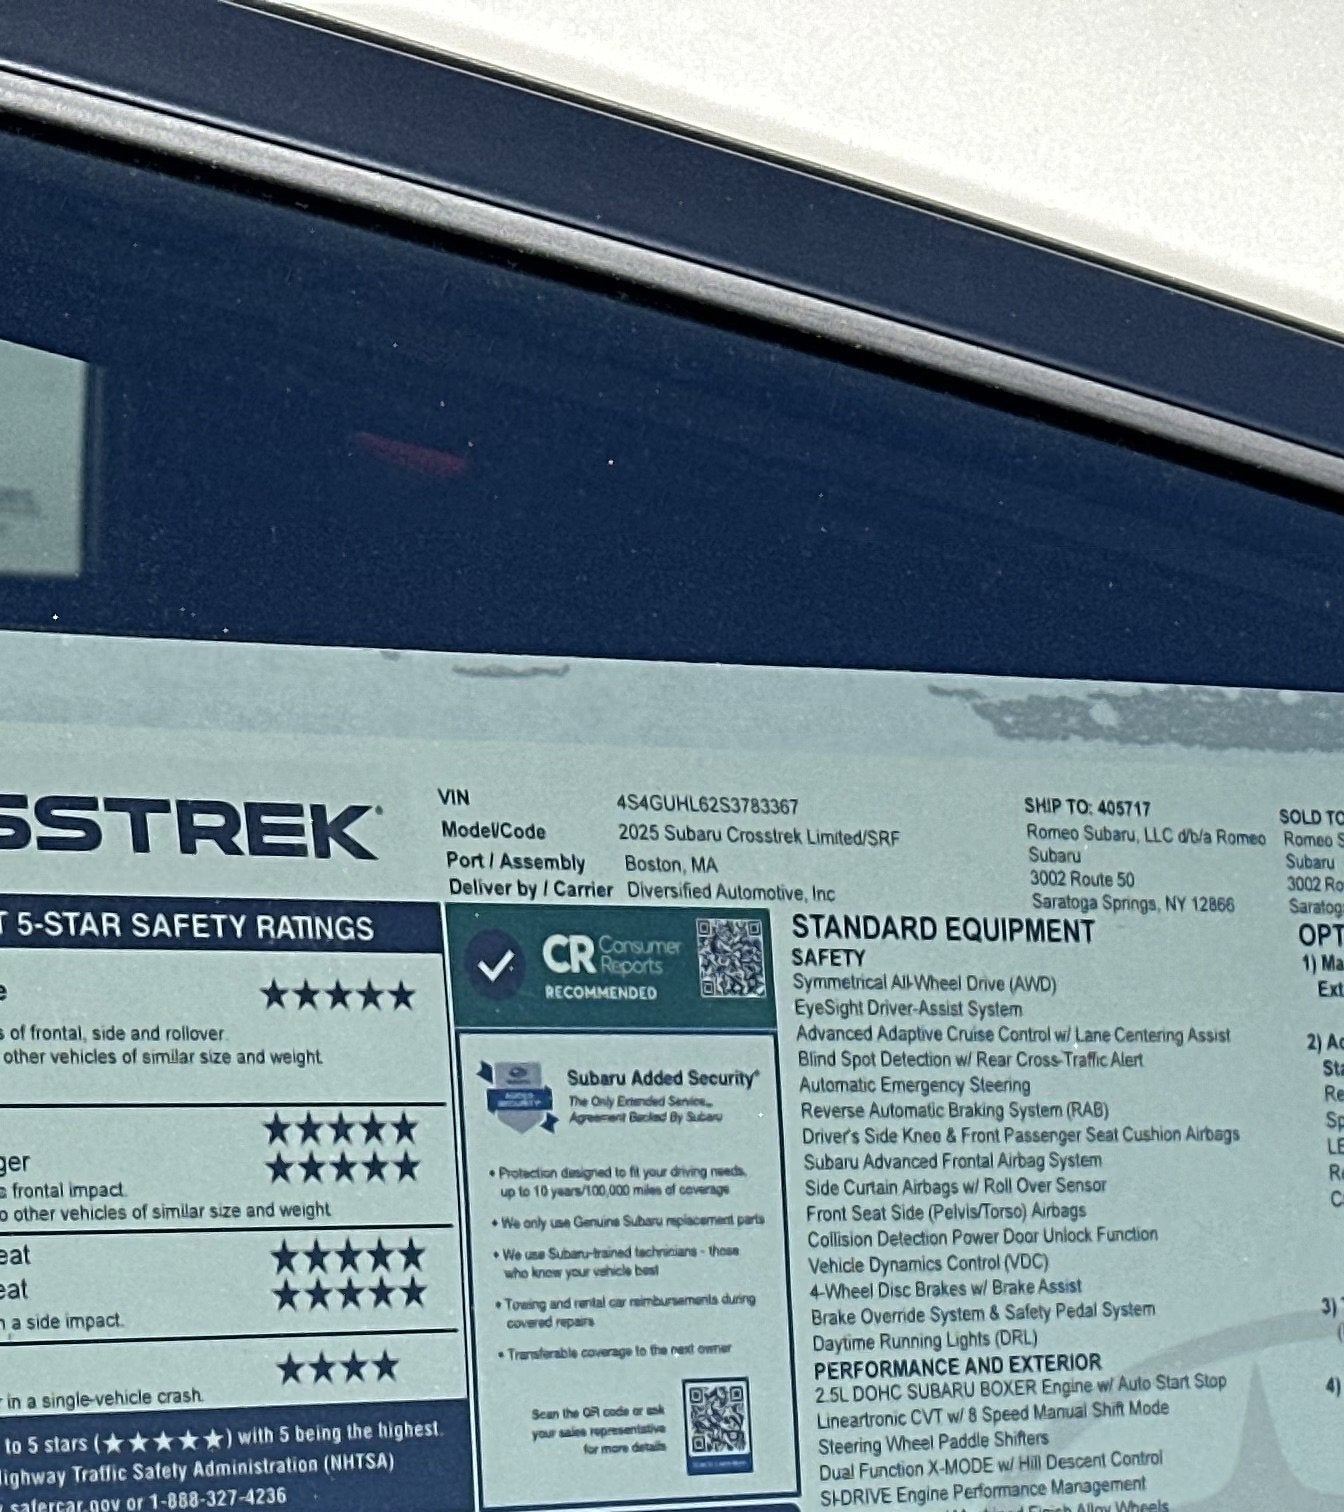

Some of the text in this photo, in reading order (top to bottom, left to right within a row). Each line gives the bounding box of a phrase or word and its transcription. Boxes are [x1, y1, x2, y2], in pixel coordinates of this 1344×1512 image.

[437, 787, 471, 806] VIN
[1024, 796, 1151, 817] SHIP TO: 405717
[441, 819, 547, 841] Model/Code
[618, 822, 901, 848] 2025 Subaru Crosstrek Limited/SRF
[17, 910, 122, 938] 5-STAR
[131, 912, 247, 939] SAFETY
[256, 914, 375, 941] RATINGS
[792, 913, 1096, 945] STANDARD EQUIPMENT
[542, 933, 597, 974] CR
[599, 934, 683, 955] Consumer
[600, 957, 664, 978] Reports
[791, 947, 866, 968] SAFETY
[544, 984, 658, 1001] RECOMMENDED
[566, 1068, 627, 1087] Subaru
[630, 1068, 684, 1087] Added
[800, 1100, 1110, 1123] Reverse Automatic Braking System (RAB)
[814, 1352, 1103, 1381] PERFORMANCE AND EXTERIOR
[126, 1497, 144, 1512] or
[148, 1486, 287, 1511] 1-888-327-4236
